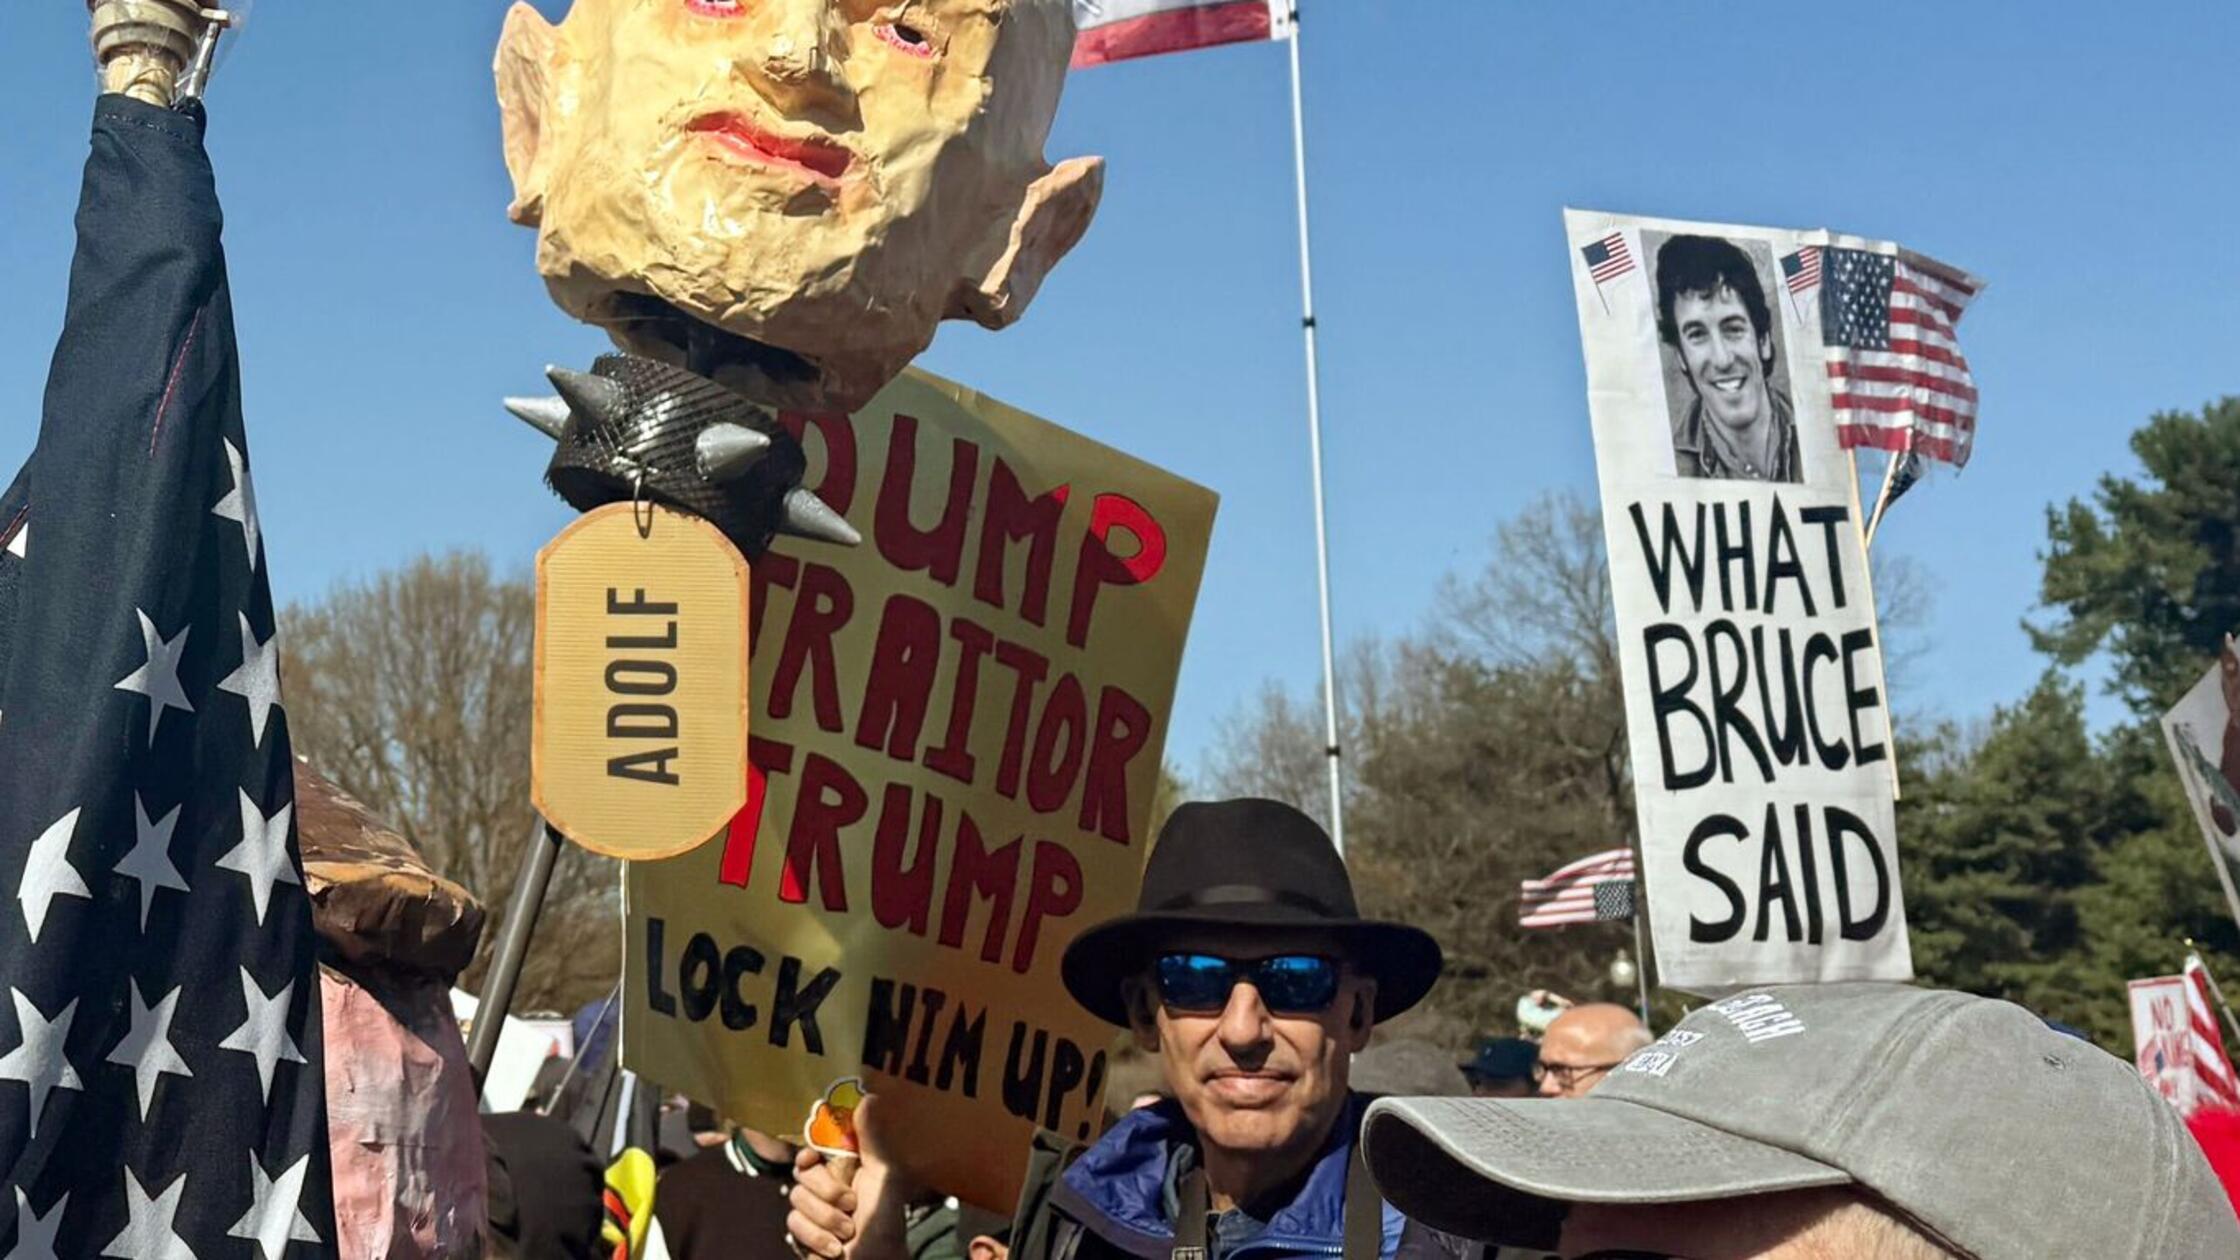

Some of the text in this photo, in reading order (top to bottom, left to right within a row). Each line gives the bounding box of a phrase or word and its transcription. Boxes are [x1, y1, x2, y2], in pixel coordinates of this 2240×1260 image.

[1628, 491, 1849, 617] WHAT
[604, 588, 680, 786] ADOLF
[1643, 619, 1887, 791] BRUCE
[719, 734, 1084, 974] TRUMP
[1683, 802, 1891, 945] SAID
[646, 917, 1108, 1140] LOCK HIM UP!
